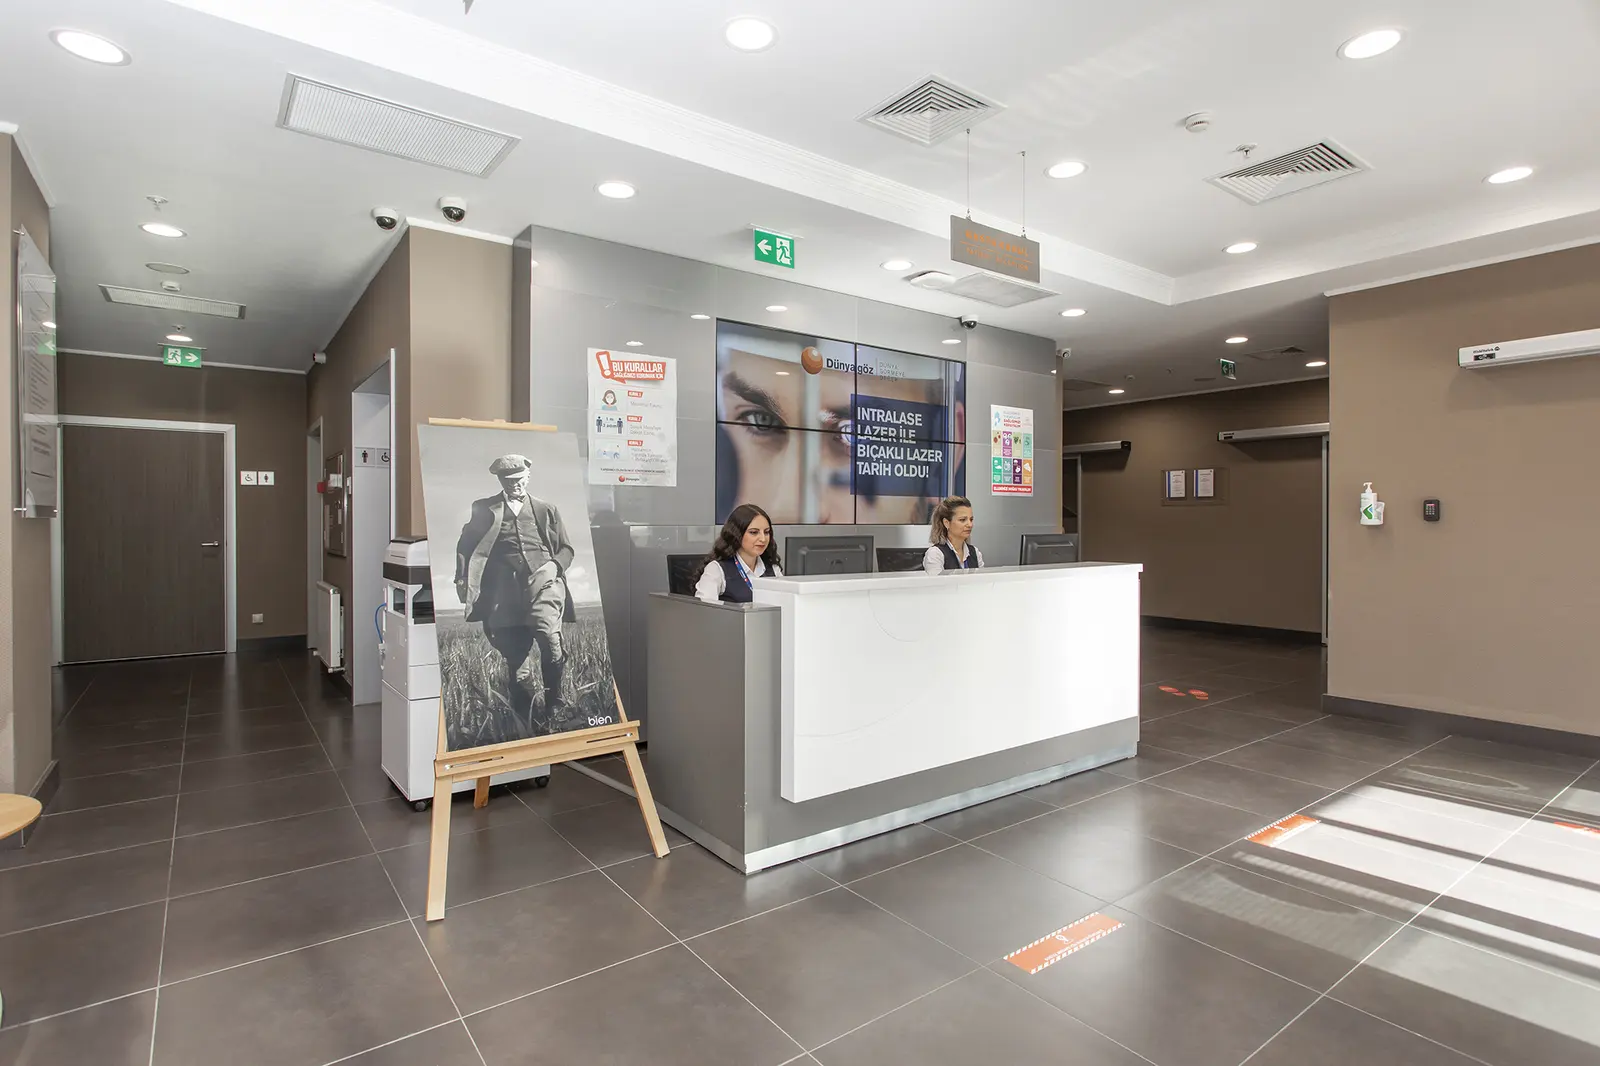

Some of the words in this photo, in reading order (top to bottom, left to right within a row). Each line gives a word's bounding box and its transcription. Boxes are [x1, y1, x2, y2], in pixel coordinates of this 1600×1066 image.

[612, 361, 623, 372] BU
[624, 362, 663, 373] KURALLAR
[826, 358, 874, 375] Dünyagöz
[857, 407, 922, 426] INTRALASE
[857, 424, 897, 442] LAZER
[899, 425, 917, 444] İLE
[857, 444, 904, 461] BIÇAKLI
[907, 448, 943, 463] LAZER
[857, 460, 891, 476] TARİH
[894, 464, 929, 478] OLDU!
[588, 715, 612, 726] bien
